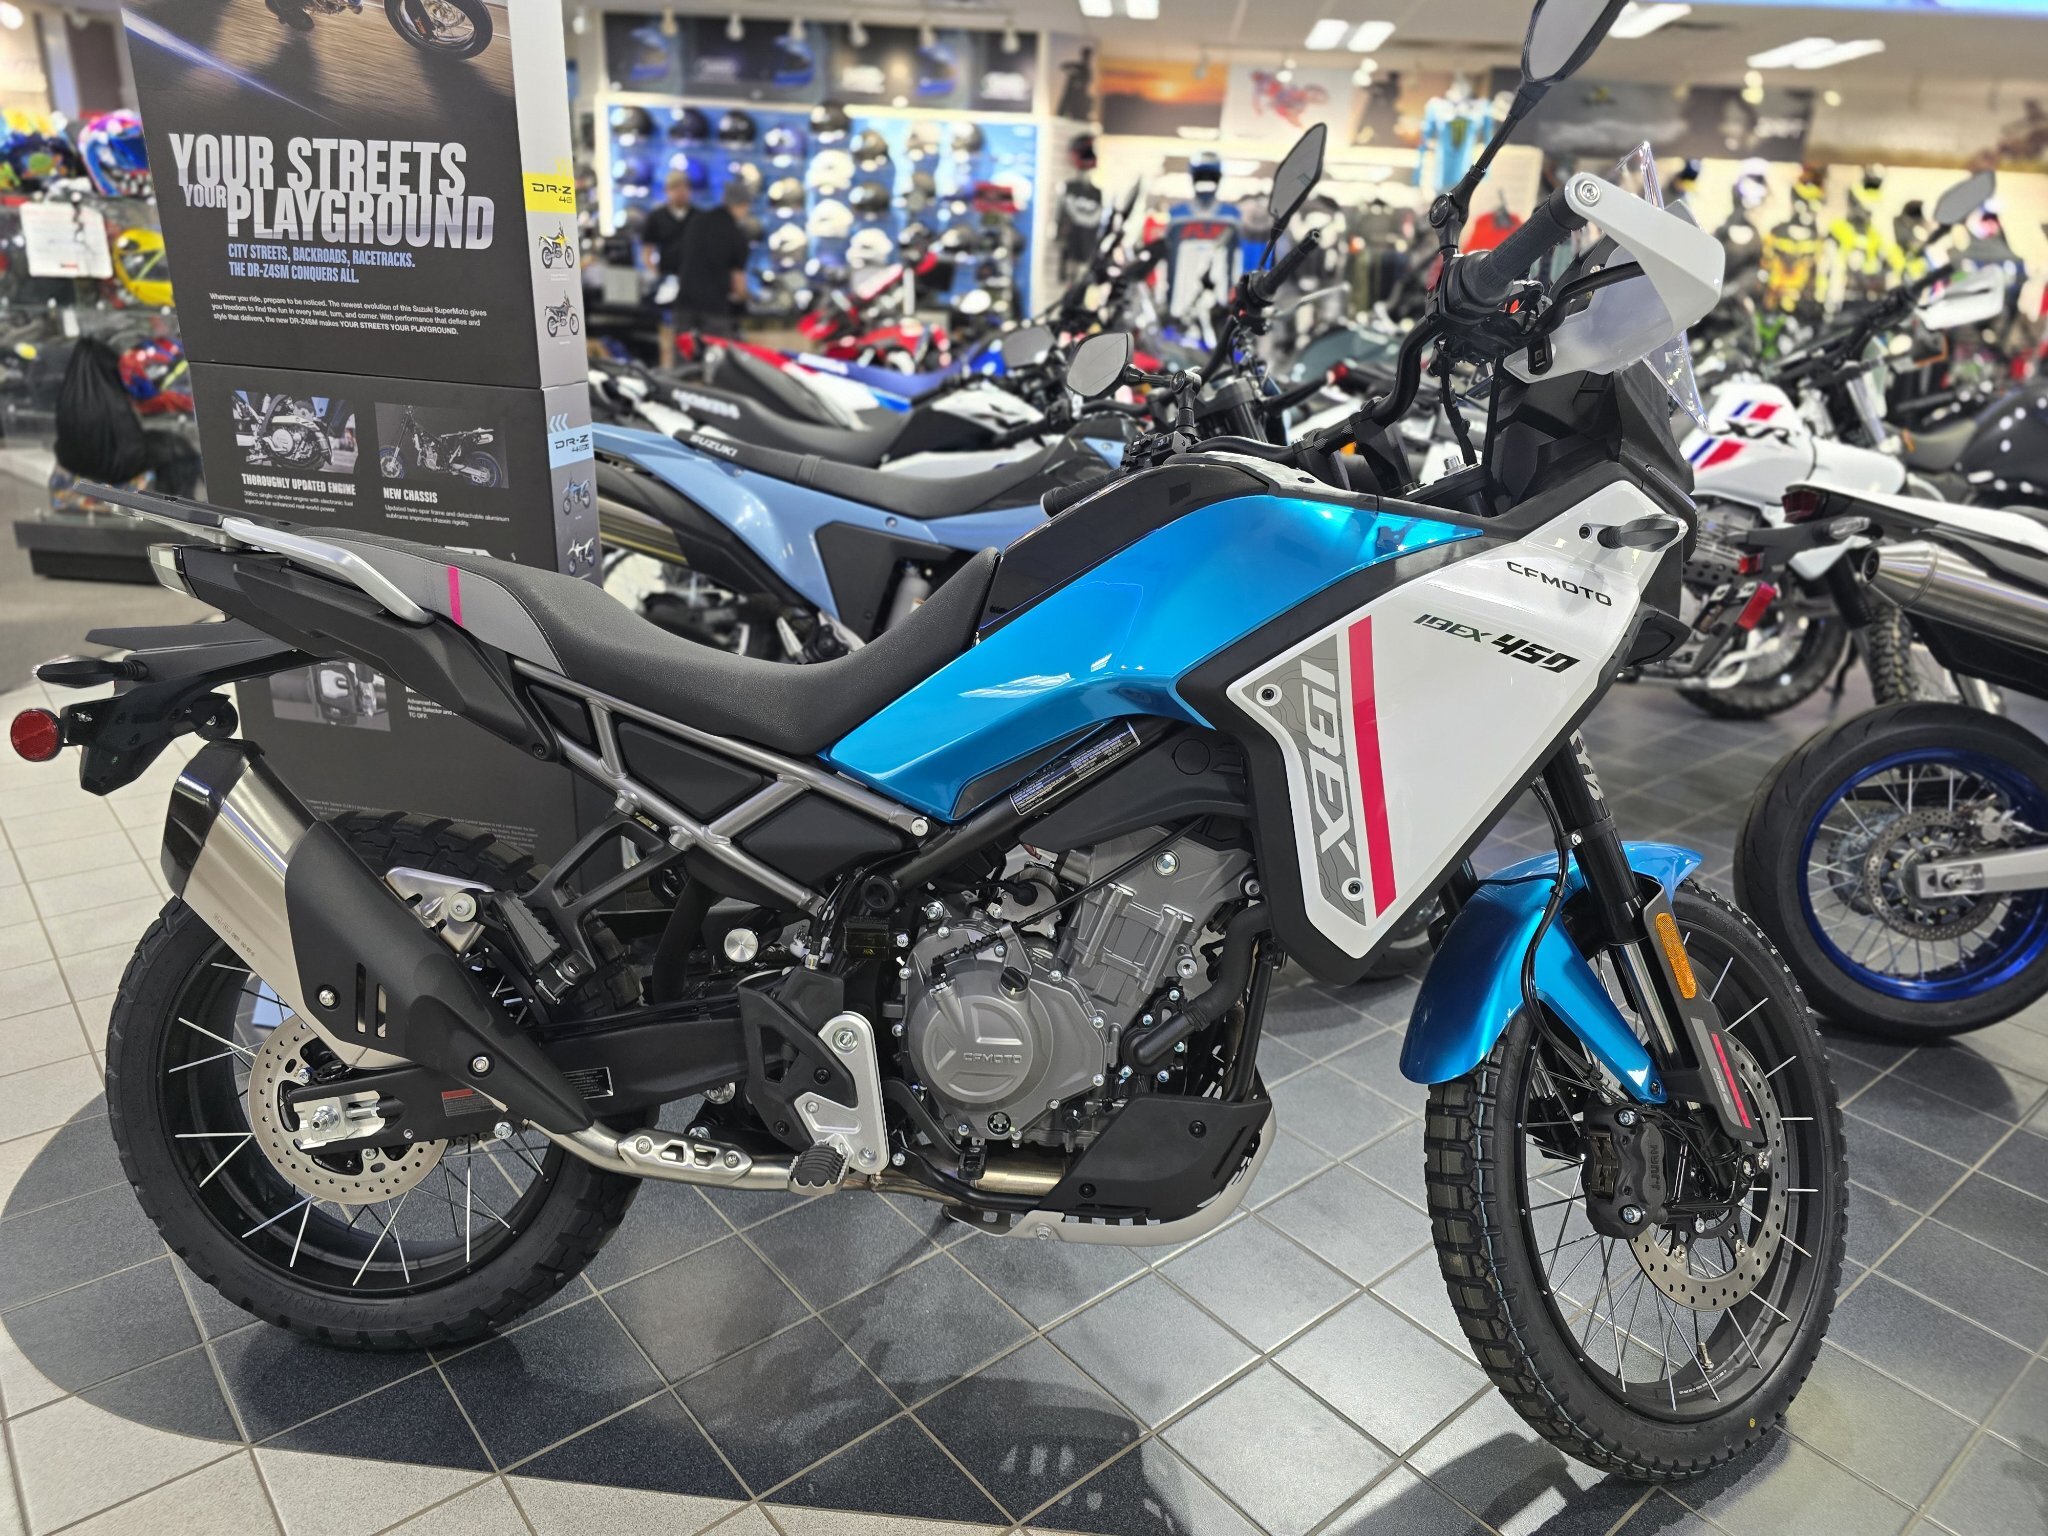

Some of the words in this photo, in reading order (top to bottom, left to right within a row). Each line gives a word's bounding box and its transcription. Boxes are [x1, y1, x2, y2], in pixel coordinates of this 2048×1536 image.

[169, 134, 274, 190] YOUR
[287, 137, 466, 198] STREETS
[532, 183, 572, 194] DR-Z
[183, 184, 226, 208] YOUR
[228, 187, 494, 250] PLAYGROUND
[228, 243, 248, 259] CITY
[251, 245, 291, 264] STREETS,
[293, 247, 350, 266] BACKROADS,
[353, 250, 415, 268] RACETRACKS.
[229, 261, 246, 277] THE
[248, 262, 289, 279] DR-Z4SM
[291, 265, 339, 282] CONQUERS
[341, 268, 359, 283] ALL.
[411, 326, 459, 334] PLAYGROUND.
[555, 434, 589, 449] DR-Z
[690, 435, 738, 457] SUZUKI
[241, 473, 290, 488] THOROUGHLY
[292, 479, 326, 492] UPDATED
[328, 482, 356, 495] ENGINE
[383, 487, 401, 500] NEW
[404, 489, 438, 503] CHASSIS
[457, 512, 484, 520] detachable
[485, 514, 509, 522] aluminum
[1507, 561, 1612, 606] CFMOTO
[1413, 614, 1493, 643] IBEX
[1491, 634, 1580, 673] 450
[1301, 659, 1356, 870] IBEX
[964, 1053, 1022, 1064] CFMOTO
